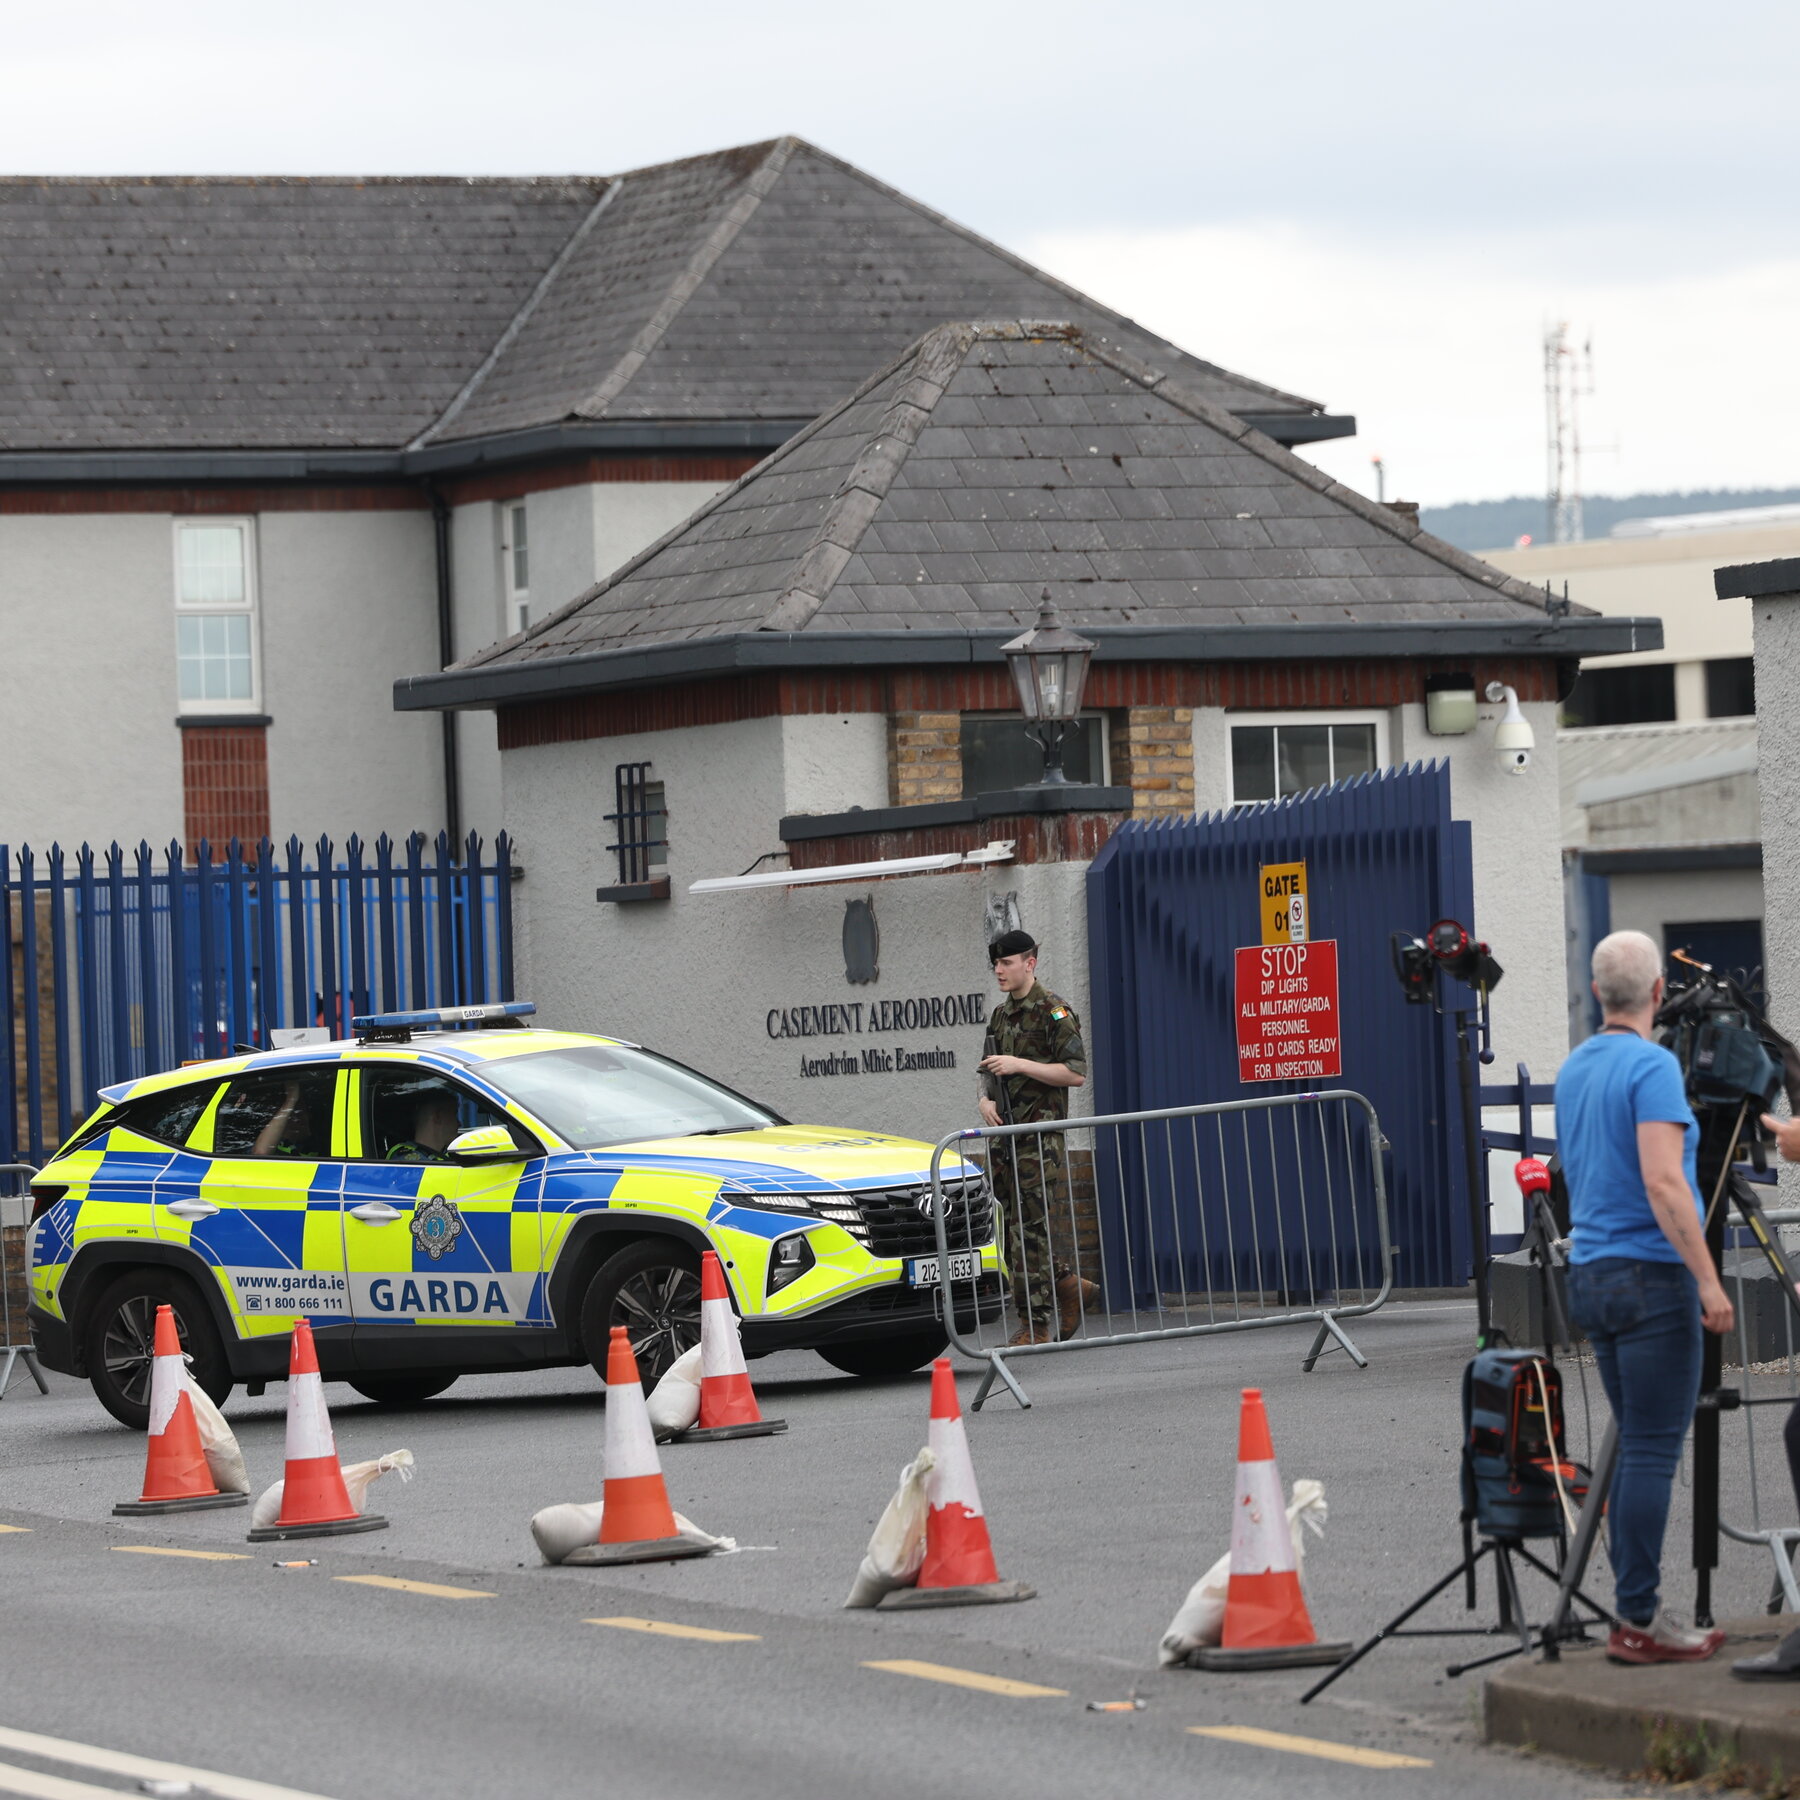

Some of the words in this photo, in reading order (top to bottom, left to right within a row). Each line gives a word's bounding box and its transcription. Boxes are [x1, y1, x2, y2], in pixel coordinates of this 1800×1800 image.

[1265, 874, 1300, 898] GATE
[1274, 911, 1289, 931] 01
[1261, 945, 1307, 978] STOP
[1261, 980, 1275, 996] DIP
[1279, 977, 1308, 994] LIGHTS
[464, 1009, 485, 1018] GARDA
[766, 1002, 863, 1040] CASEMENT
[868, 993, 987, 1033] AERODROME
[1242, 1002, 1256, 1018] ALL
[1260, 996, 1330, 1016] MILITARY/GARDA
[1261, 1019, 1310, 1037] PERSONNEL
[1240, 1043, 1261, 1059] HAVE
[1278, 1040, 1305, 1057] CARDS
[1308, 1037, 1337, 1054] READY
[861, 1048, 893, 1074] Mhic
[1254, 1063, 1272, 1079] FOR
[1275, 1060, 1323, 1077] INSPECTION
[921, 1258, 972, 1282] 212--1633
[236, 1274, 345, 1292] www.garda.ie
[265, 1297, 271, 1308] 1
[275, 1297, 296, 1309] 800
[299, 1298, 319, 1310] 666
[323, 1298, 343, 1310] 111
[369, 1278, 510, 1314] GARDA
